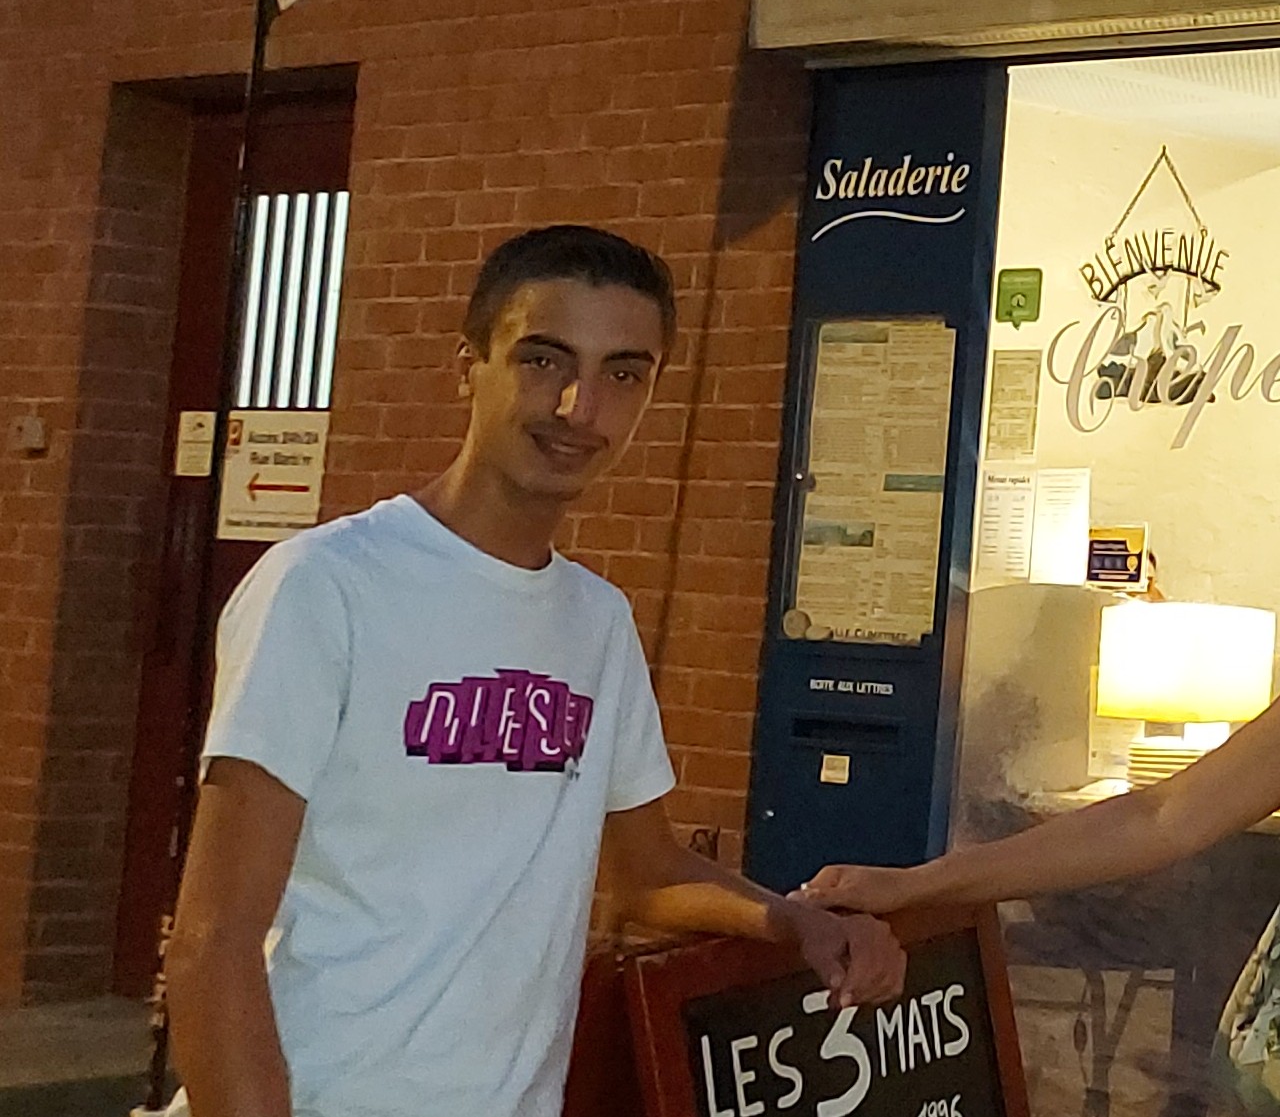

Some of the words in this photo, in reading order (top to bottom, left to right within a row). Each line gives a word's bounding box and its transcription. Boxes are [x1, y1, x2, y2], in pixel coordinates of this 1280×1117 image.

[815, 152, 970, 200] Saladerie
[1078, 228, 1230, 299] BIENVENUE
[701, 1026, 803, 1117] LES
[802, 989, 871, 1117] 3
[877, 984, 970, 1077] MATS
